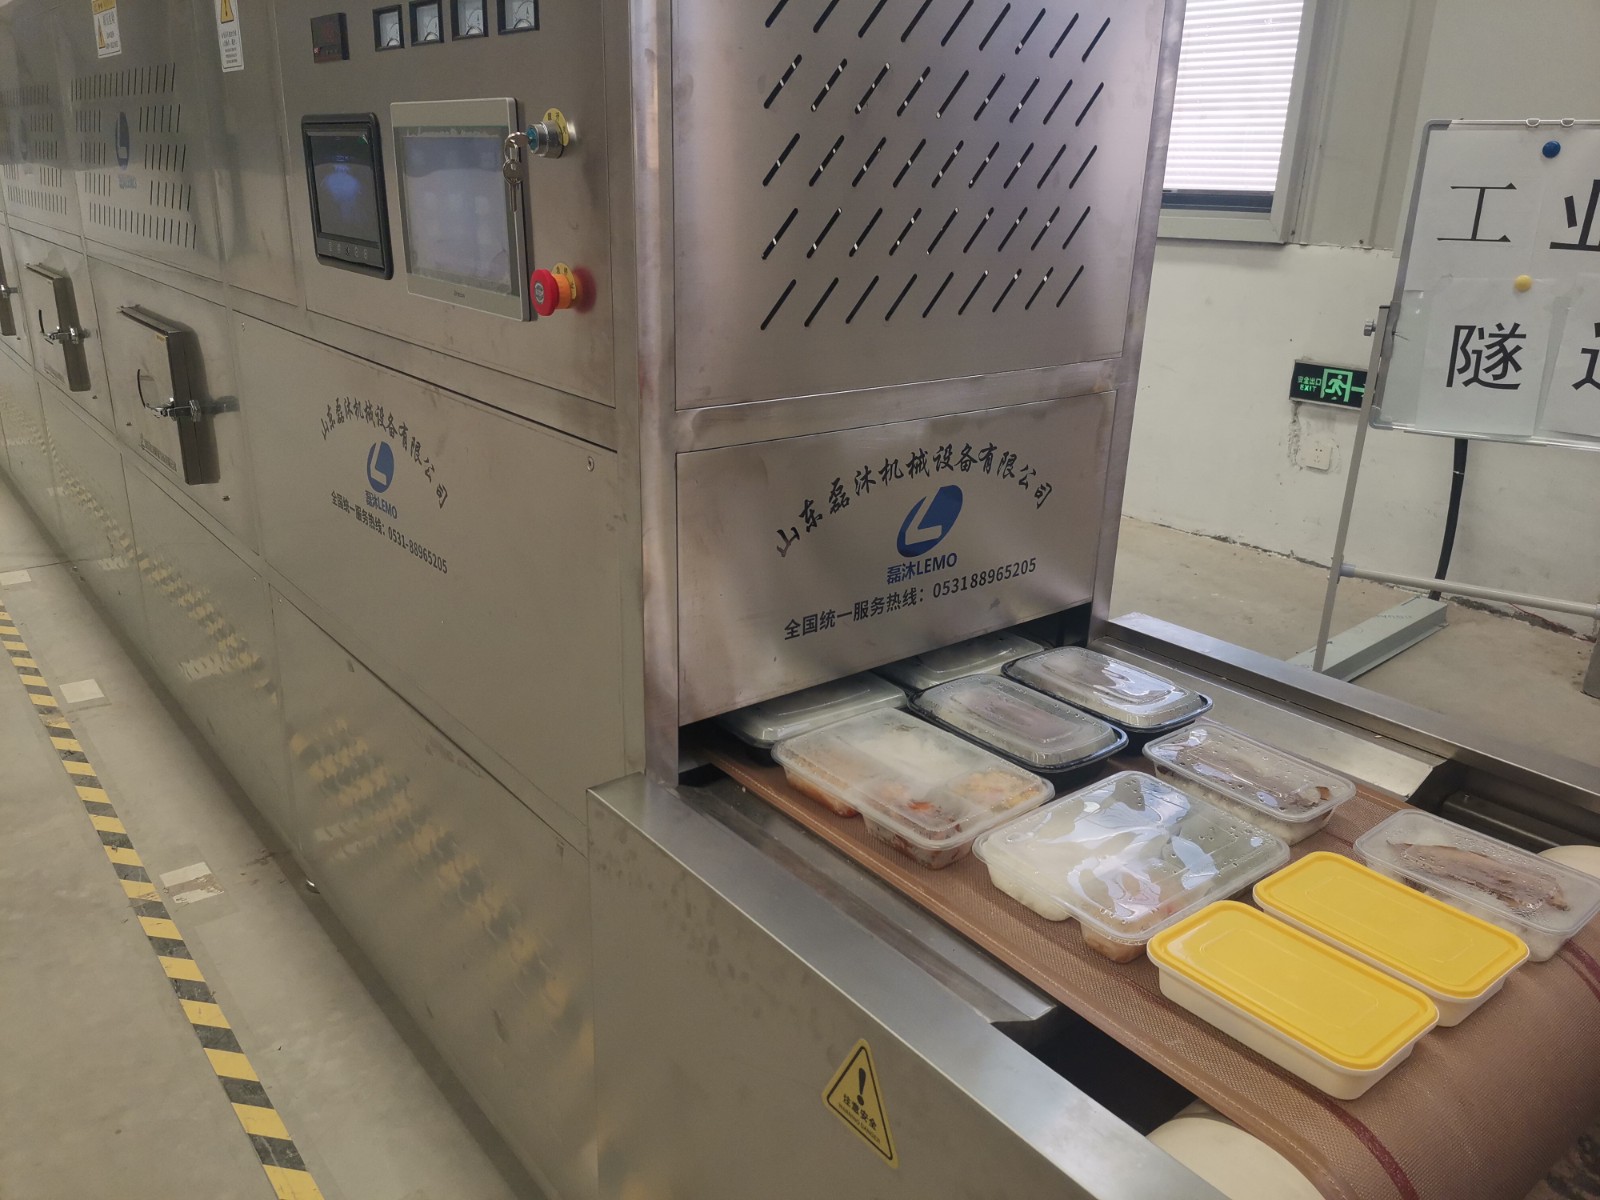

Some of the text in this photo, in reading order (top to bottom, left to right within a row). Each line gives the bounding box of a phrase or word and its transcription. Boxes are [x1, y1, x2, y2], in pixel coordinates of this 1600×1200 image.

[321, 397, 448, 508] 山东磊沐机械设备有限公司
[777, 443, 1052, 557] 山东磊沐机械设备有限公司
